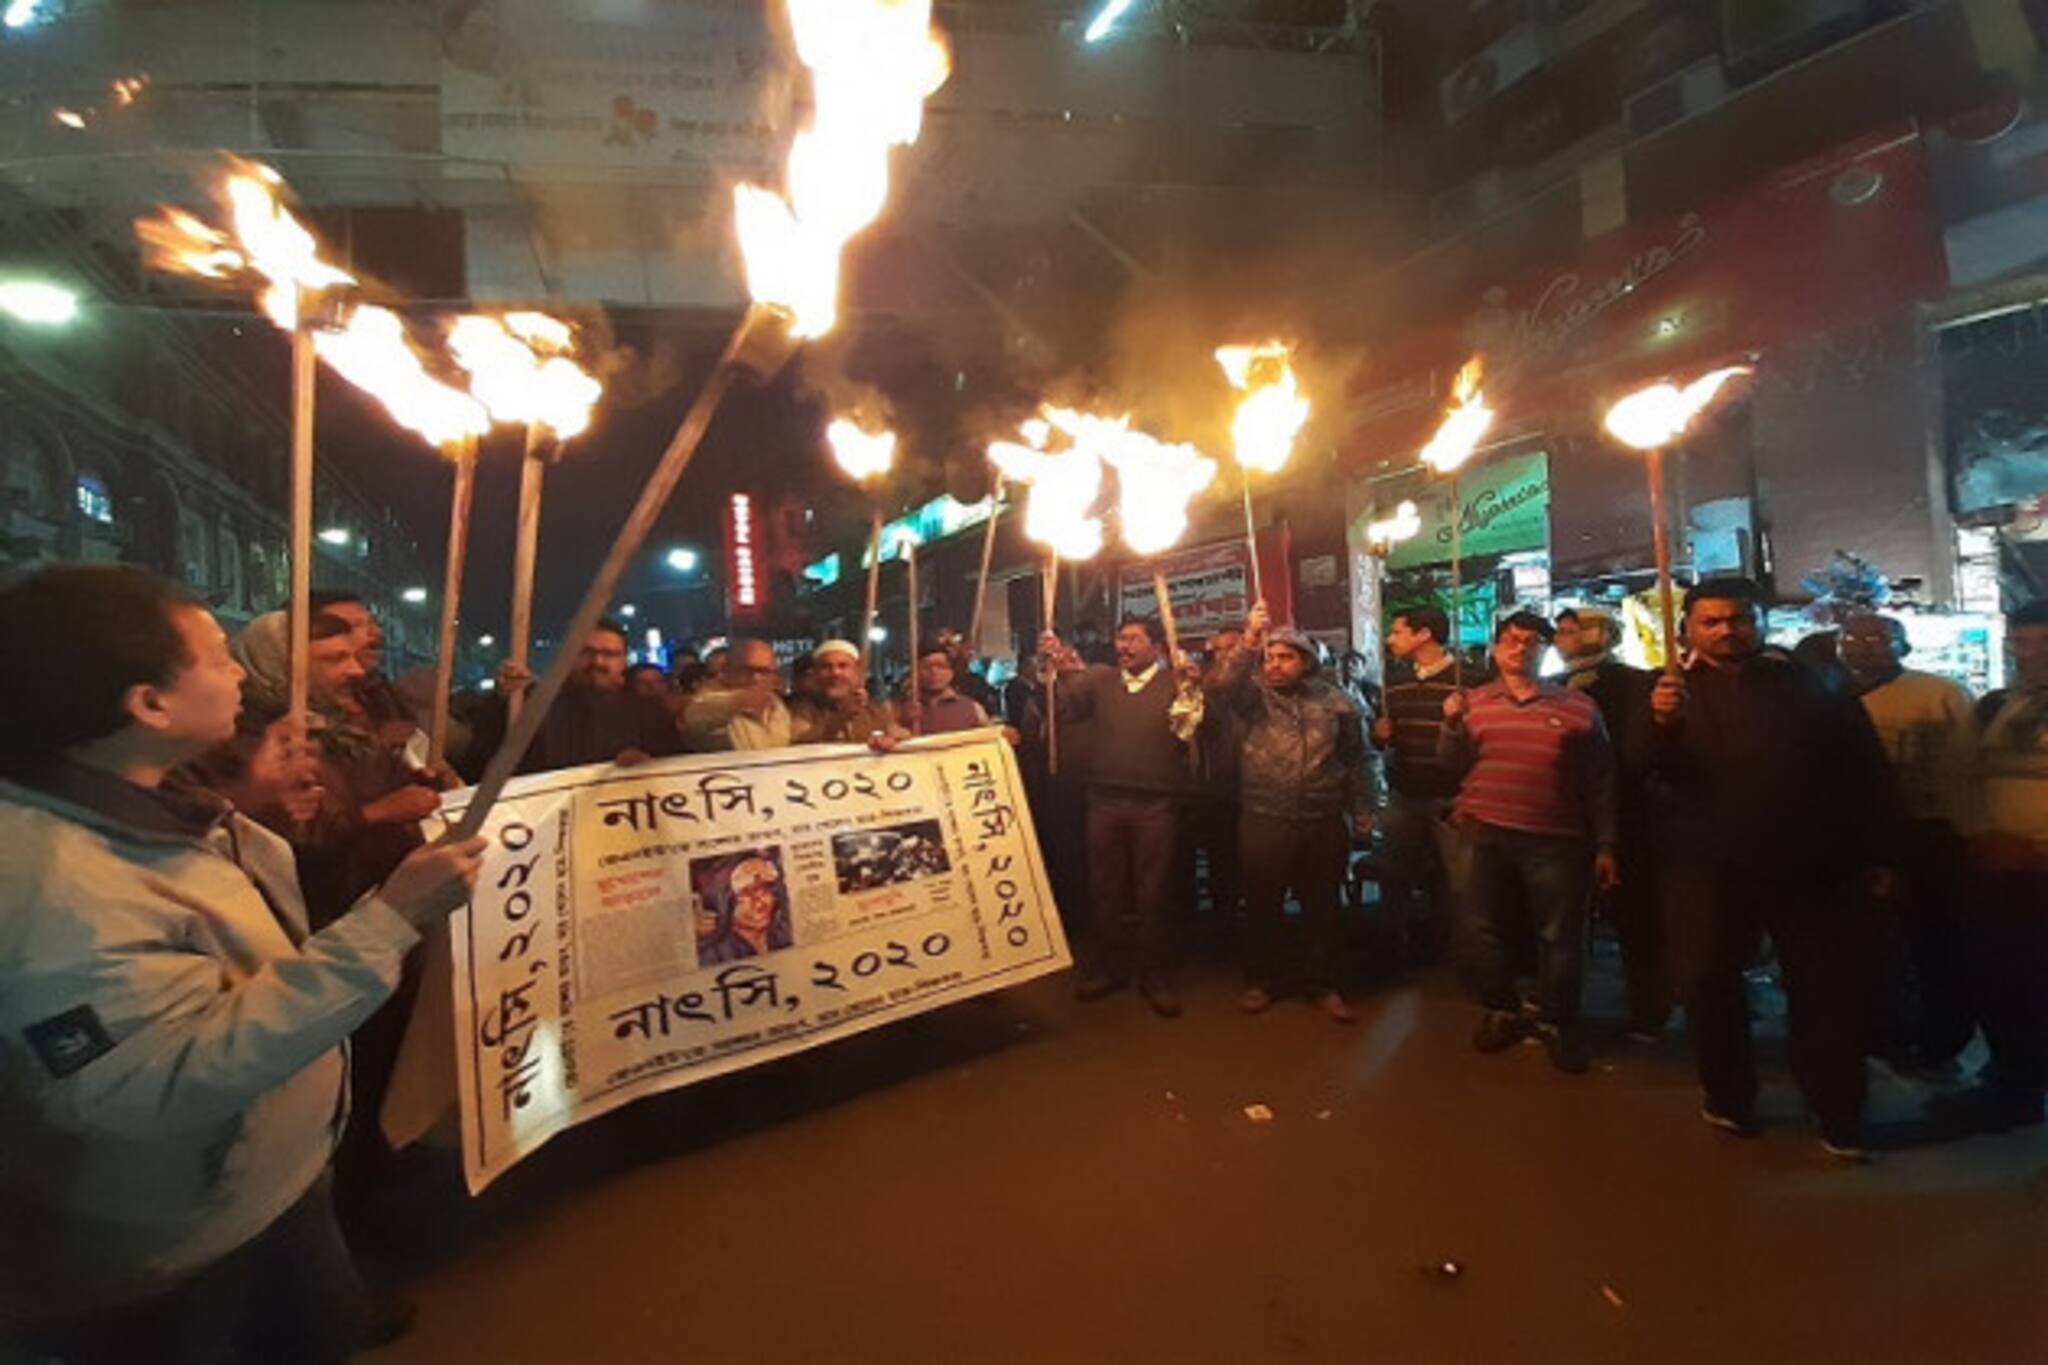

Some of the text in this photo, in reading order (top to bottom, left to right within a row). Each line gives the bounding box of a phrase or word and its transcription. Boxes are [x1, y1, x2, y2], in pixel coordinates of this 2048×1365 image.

[785, 771, 914, 808] ২০২০
[497, 822, 541, 960] ২০২০
[986, 856, 1029, 947] ২০২০
[810, 932, 951, 991] ২০২০
